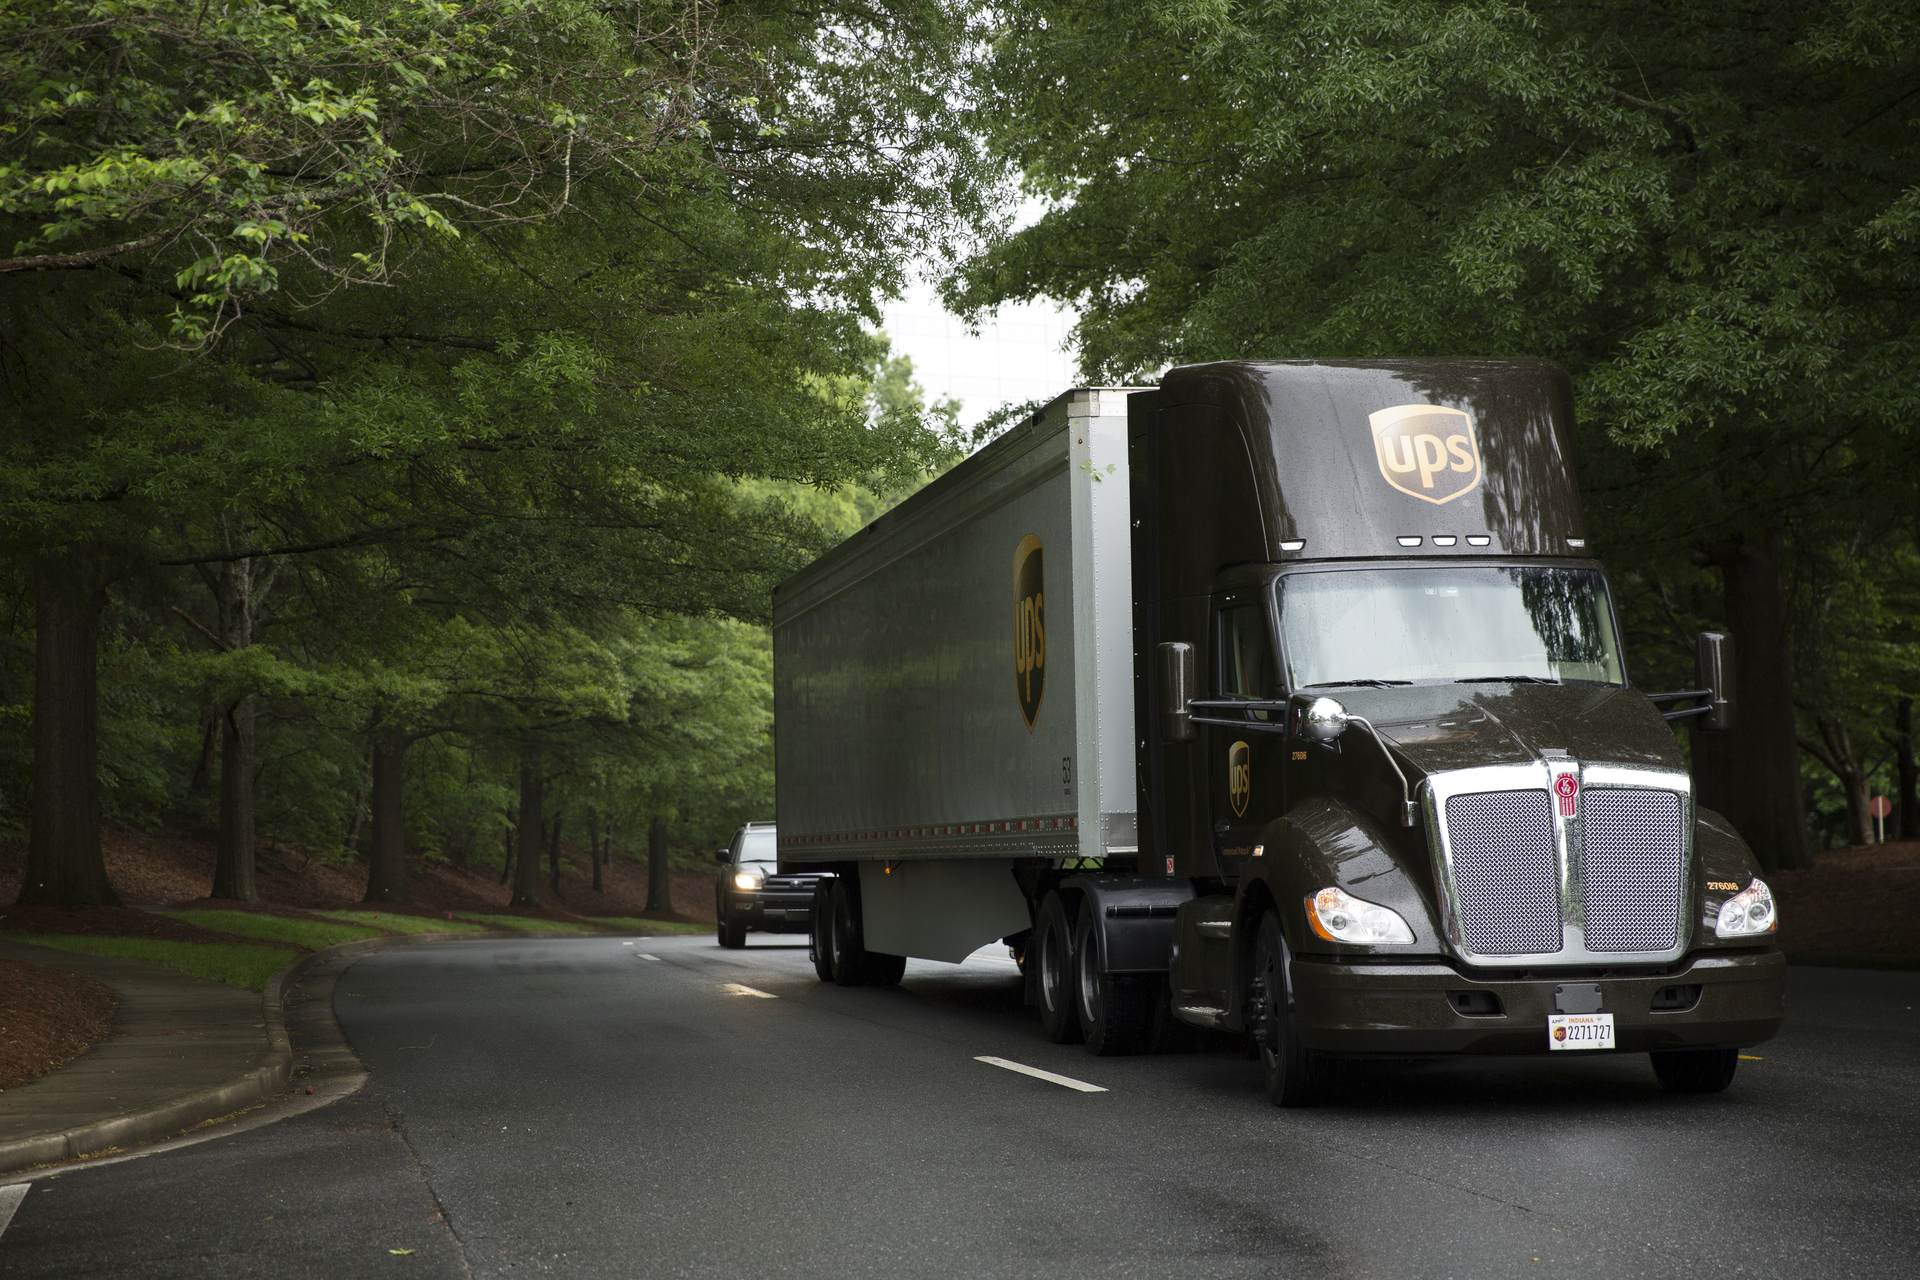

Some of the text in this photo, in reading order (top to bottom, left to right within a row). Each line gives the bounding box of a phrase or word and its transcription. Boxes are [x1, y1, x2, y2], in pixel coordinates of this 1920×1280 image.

[1382, 434, 1474, 488] ups
[1015, 592, 1044, 703] ups
[1231, 763, 1248, 806] ups
[1706, 881, 1739, 891] 276016
[1568, 1024, 1611, 1040] 2271727
